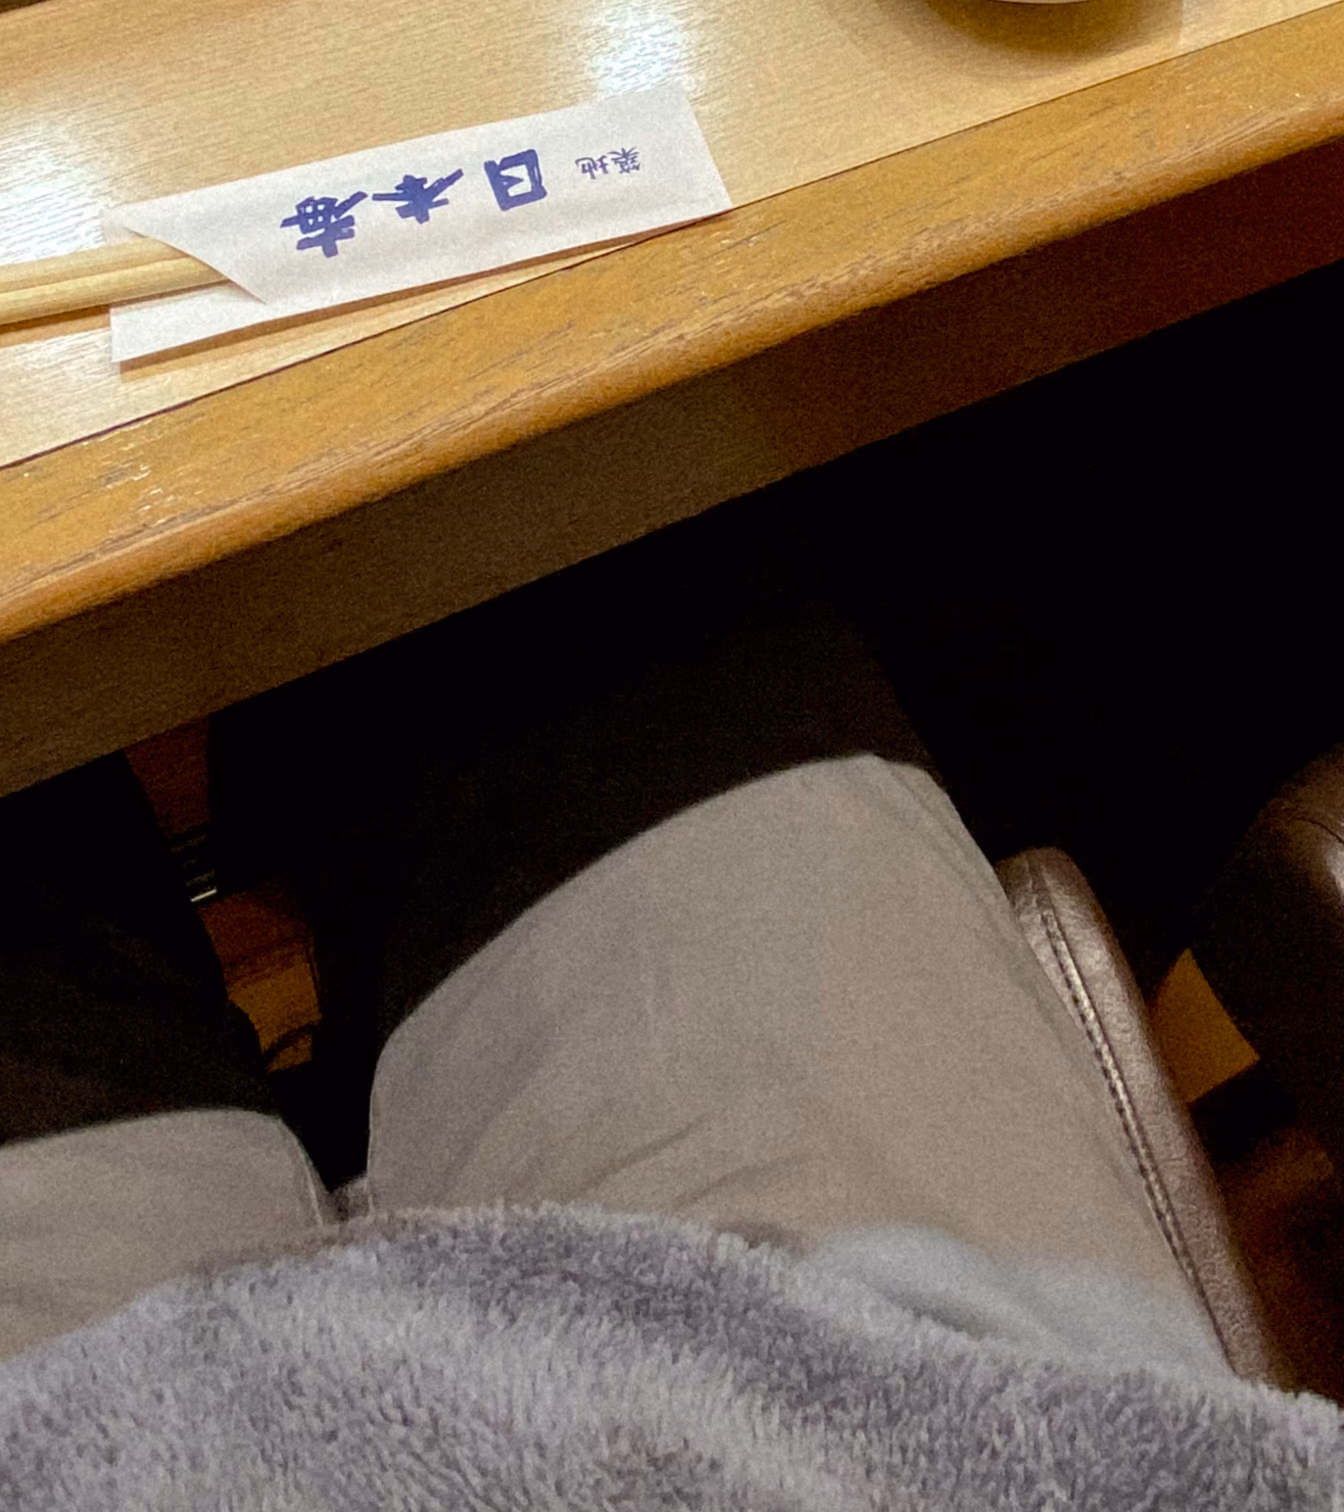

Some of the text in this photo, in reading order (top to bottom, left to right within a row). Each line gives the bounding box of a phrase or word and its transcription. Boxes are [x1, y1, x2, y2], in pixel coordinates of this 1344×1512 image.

[280, 147, 642, 258] 日本海 築地
